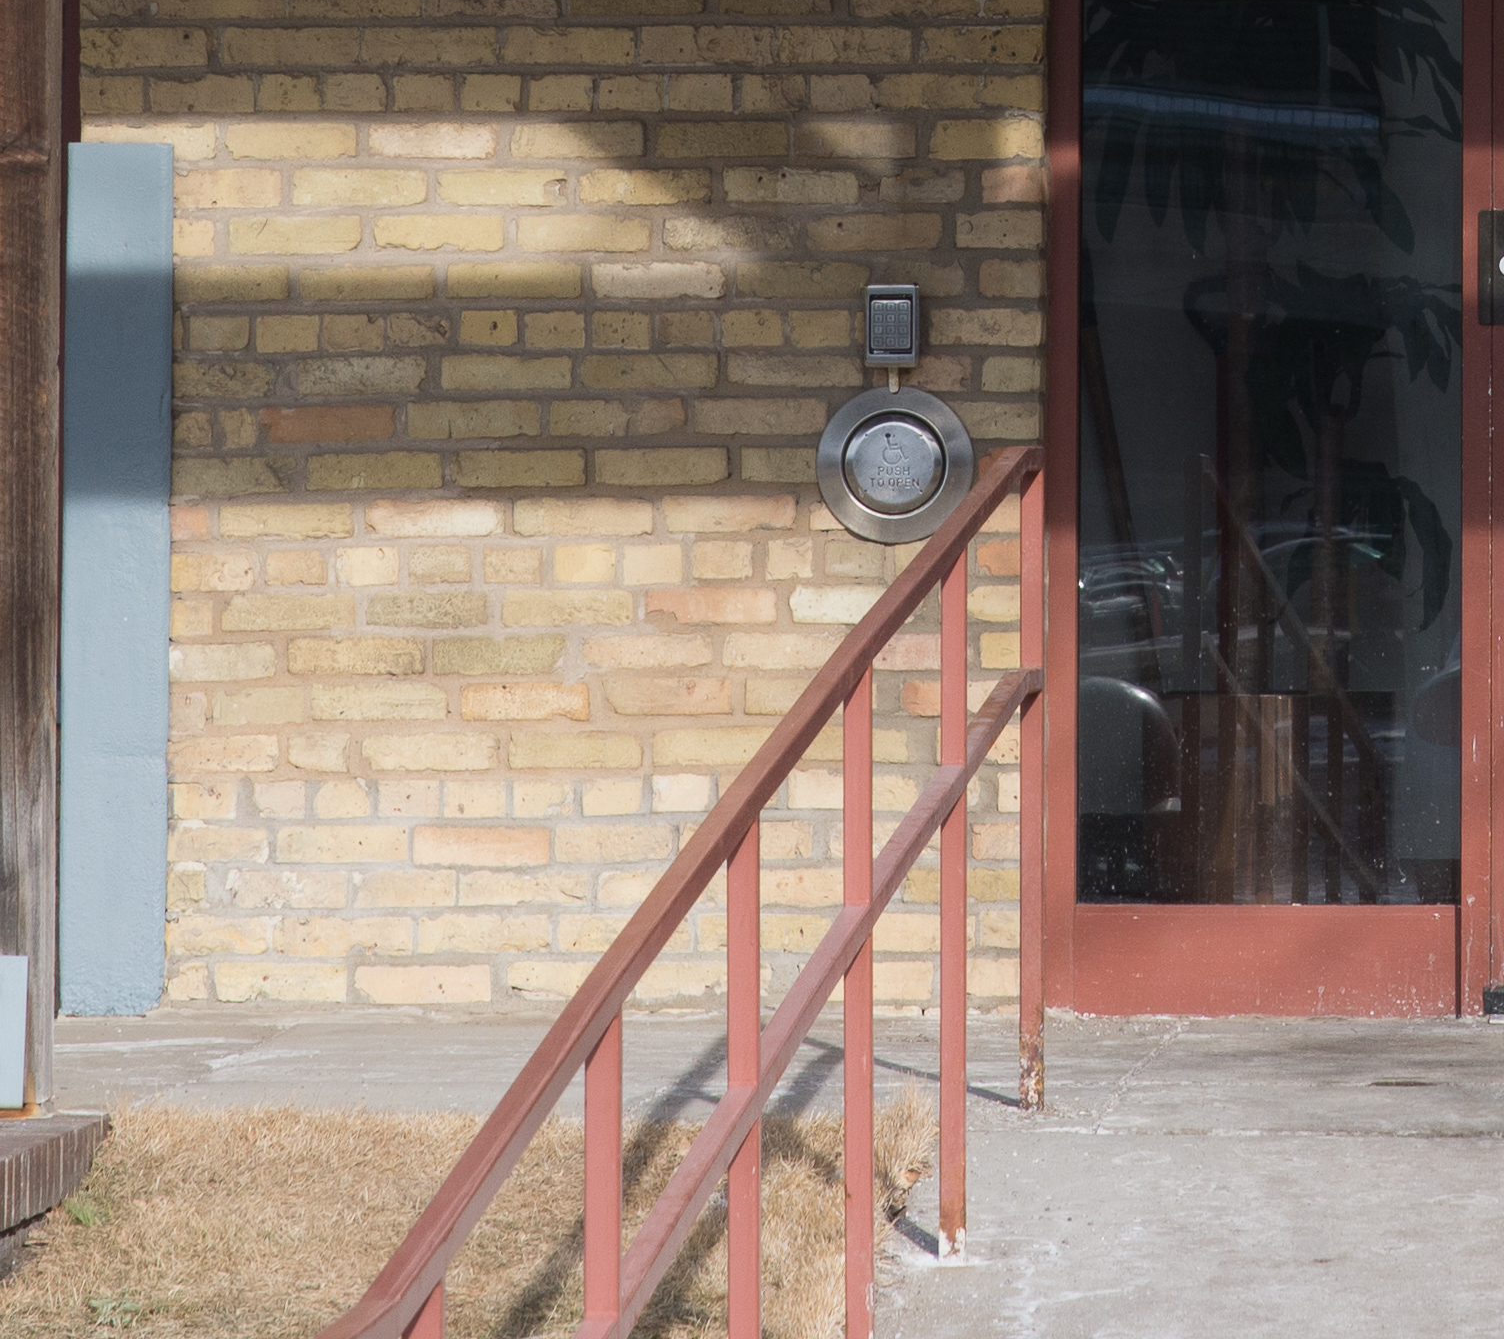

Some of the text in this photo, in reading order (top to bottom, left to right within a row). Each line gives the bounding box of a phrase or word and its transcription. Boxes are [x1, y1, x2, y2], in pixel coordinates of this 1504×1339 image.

[877, 466, 910, 476] PUSH
[869, 477, 920, 487] TO OPEN
